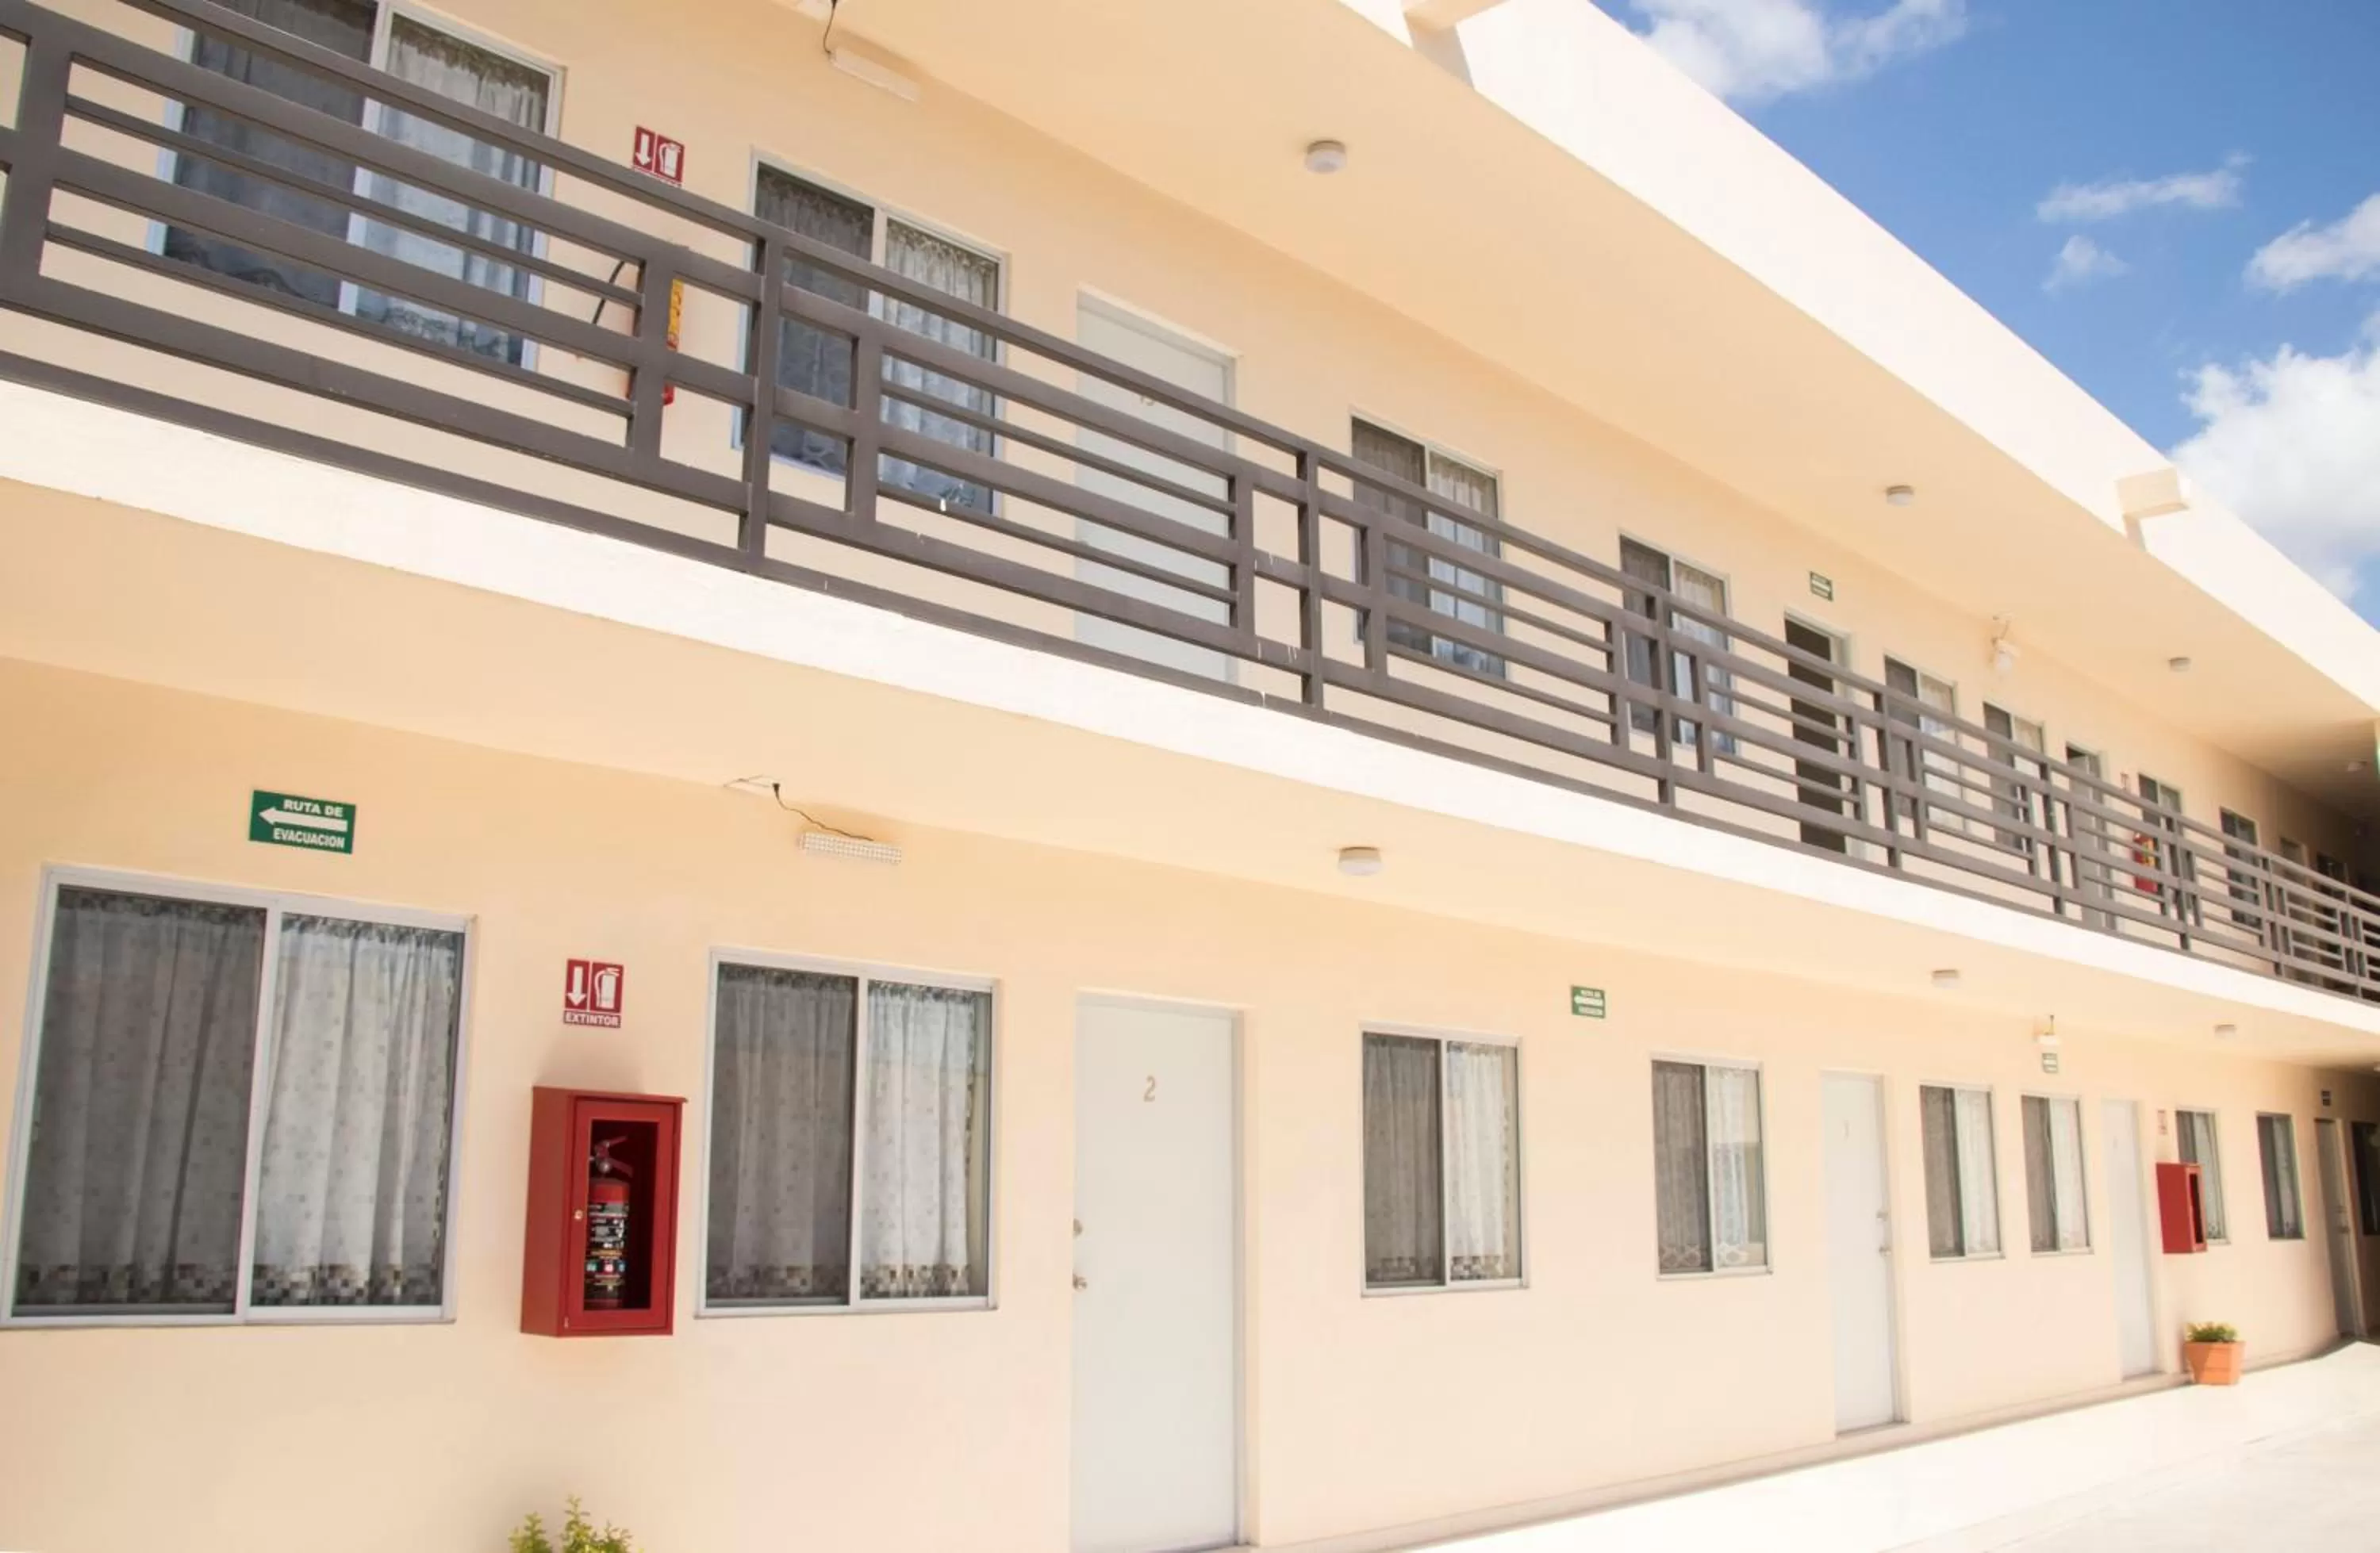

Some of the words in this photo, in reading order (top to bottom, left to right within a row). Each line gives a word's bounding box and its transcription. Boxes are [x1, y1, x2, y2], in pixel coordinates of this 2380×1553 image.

[283, 799, 321, 814] RUTA
[324, 805, 344, 818] DE
[273, 827, 345, 849] EVACUACION
[566, 1011, 619, 1026] EXTINTOR
[1143, 1075, 1157, 1102] 2
